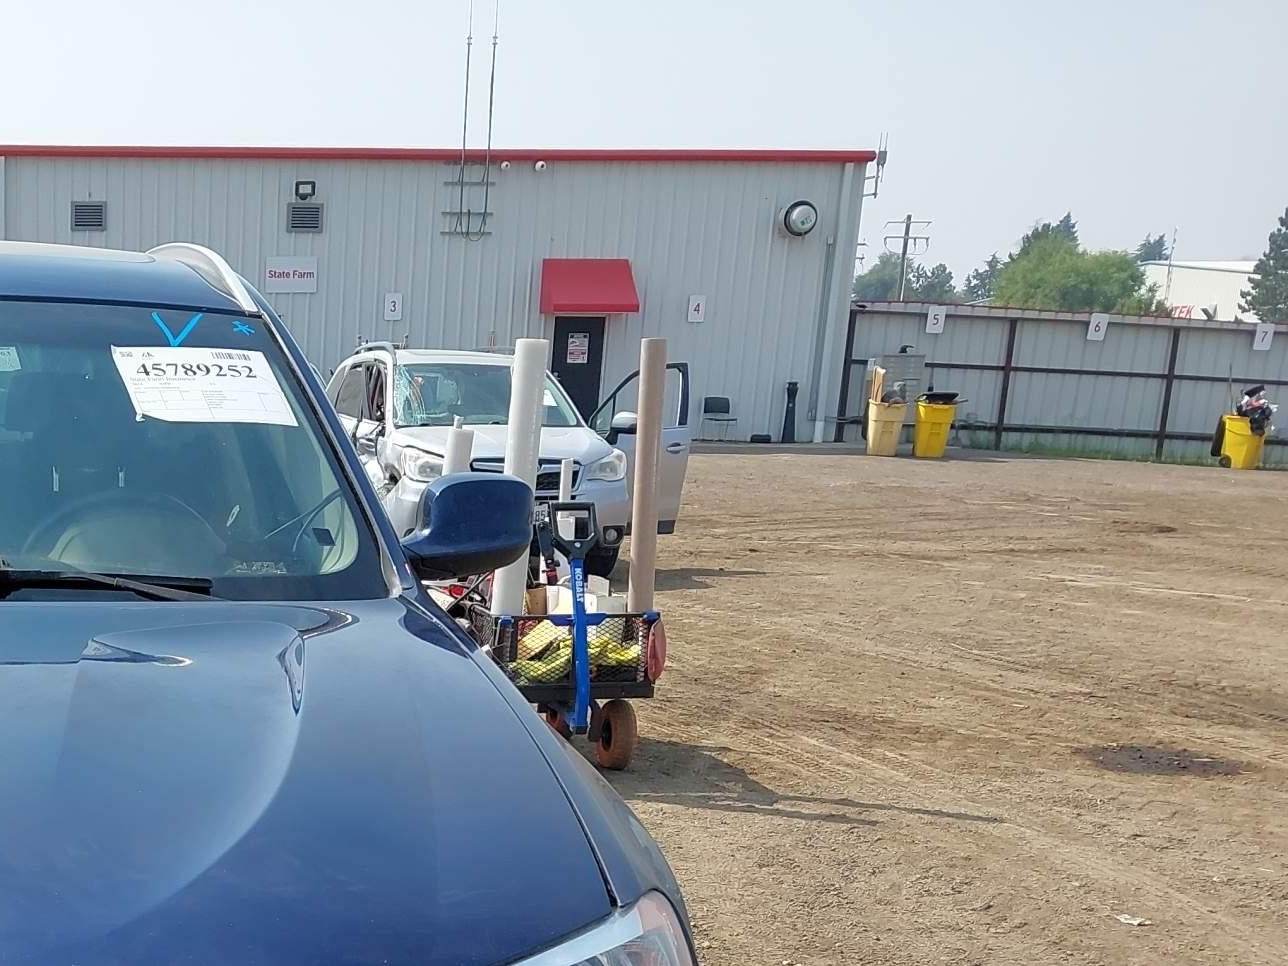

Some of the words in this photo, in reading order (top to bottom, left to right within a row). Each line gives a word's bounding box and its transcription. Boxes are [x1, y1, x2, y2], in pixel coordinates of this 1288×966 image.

[268, 270, 290, 279] State
[292, 270, 315, 279] Farm
[389, 300, 397, 312] 3
[693, 302, 700, 314] 4
[932, 313, 940, 326] 5
[1094, 321, 1101, 333] 6
[1261, 330, 1269, 343] 7
[136, 362, 257, 378] 45789252
[575, 567, 584, 602] KOBALT
